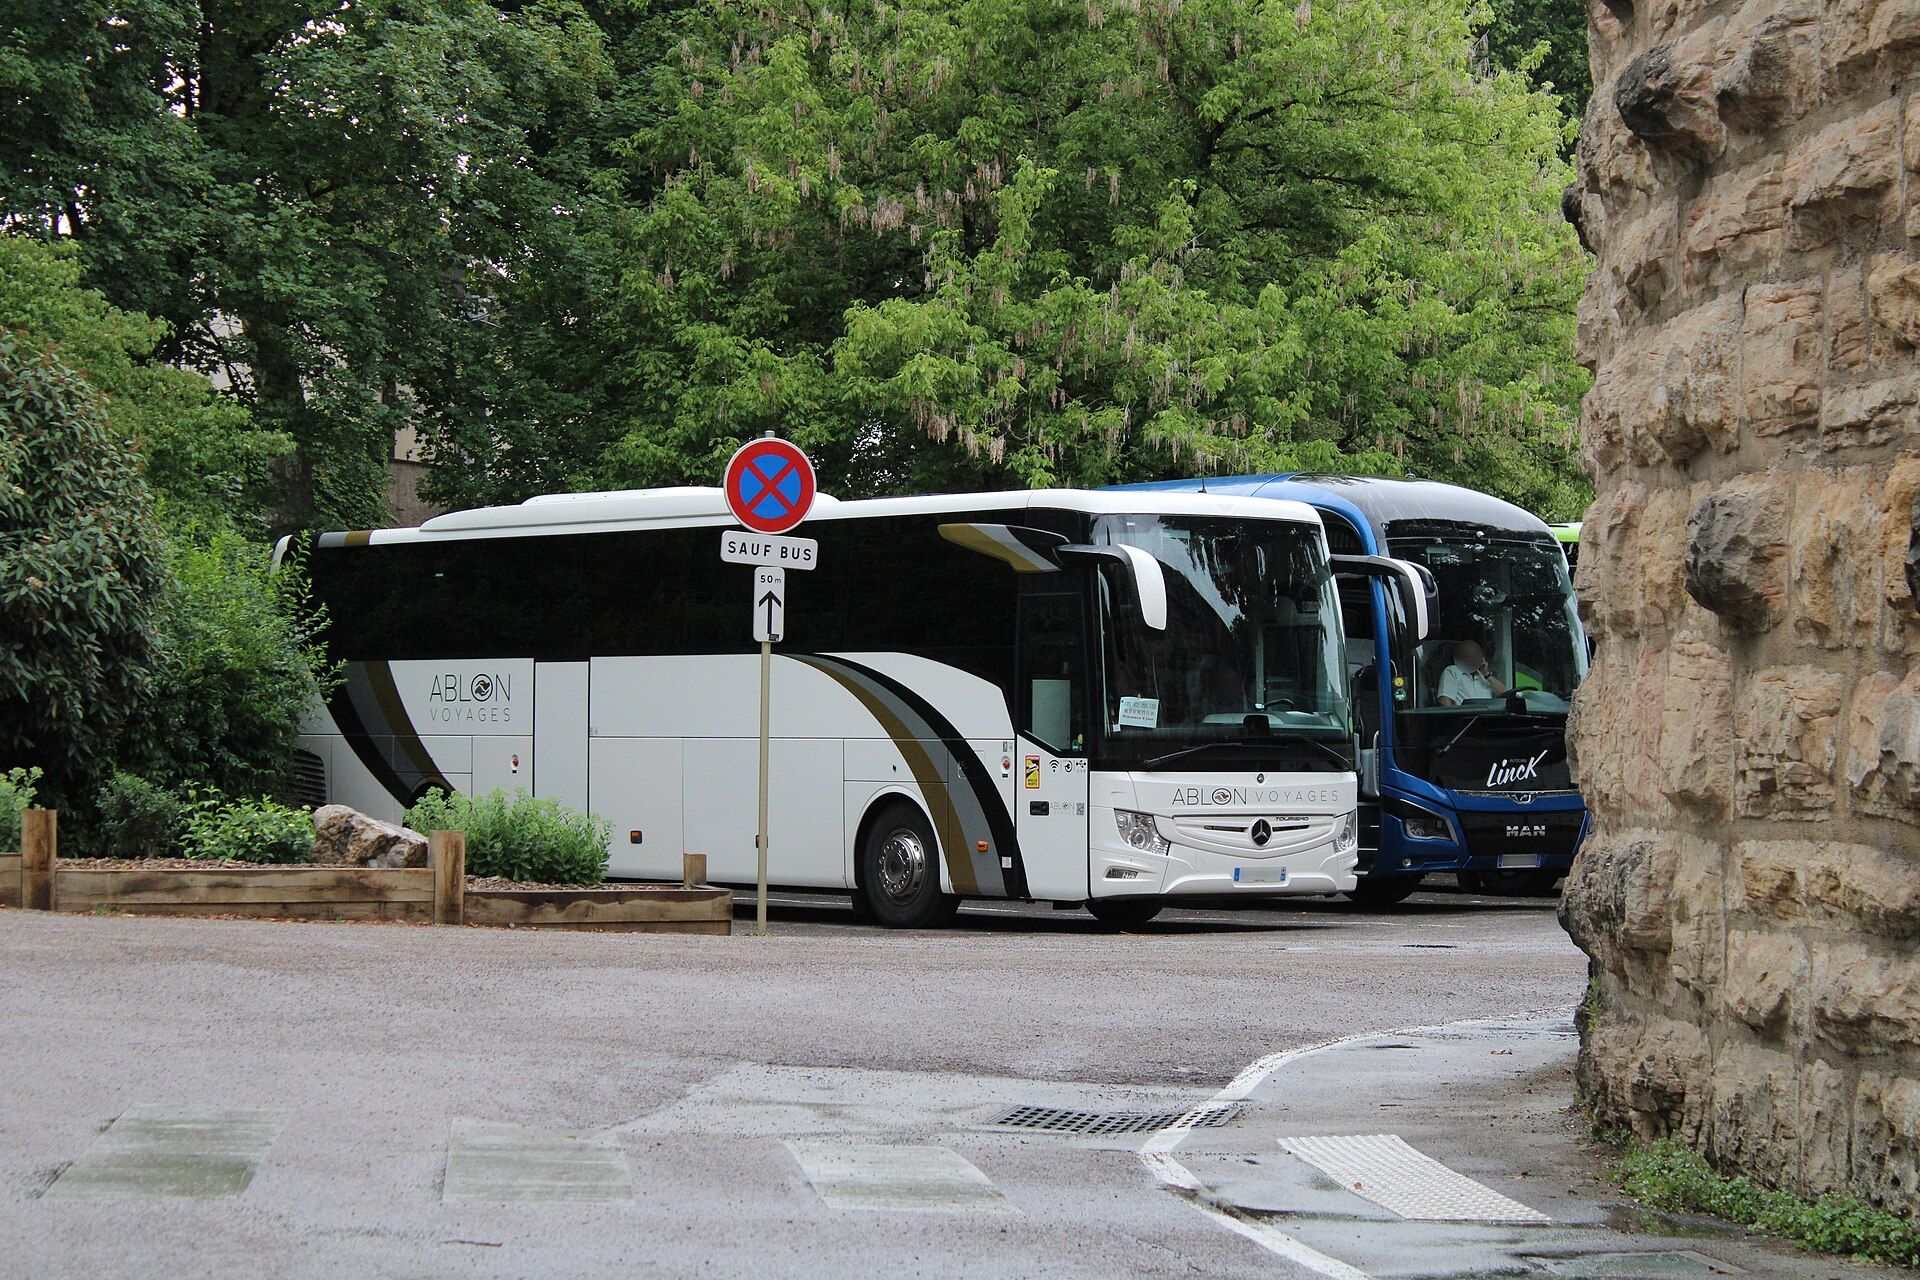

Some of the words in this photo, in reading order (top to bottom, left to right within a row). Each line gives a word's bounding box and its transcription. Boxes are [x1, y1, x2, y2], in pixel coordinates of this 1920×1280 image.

[728, 541, 771, 556] SAUF
[780, 546, 811, 561] BUS
[429, 673, 511, 702] ABLON
[430, 707, 511, 722] VOYAGES
[1171, 787, 1247, 806] ABLON
[1254, 790, 1339, 803] VOYAGES
[1506, 825, 1546, 837] MAN
